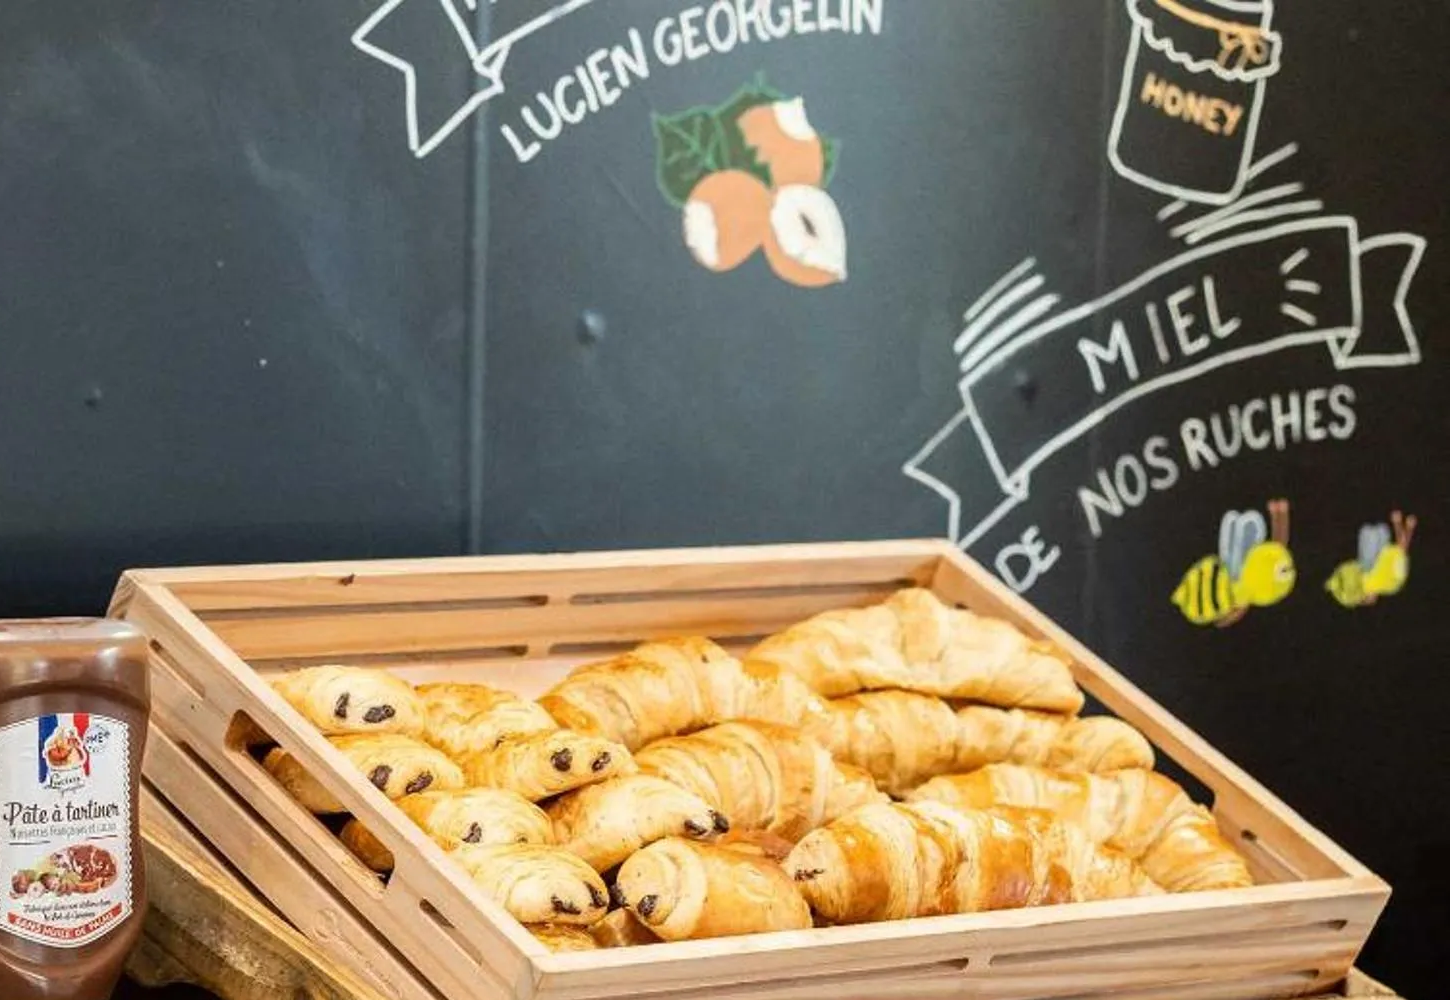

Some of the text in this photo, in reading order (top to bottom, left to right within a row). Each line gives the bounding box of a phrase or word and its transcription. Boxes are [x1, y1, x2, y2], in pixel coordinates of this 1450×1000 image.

[501, 0, 883, 163] LUCIEN GEORGELIN
[1140, 71, 1245, 137] HONEY
[1076, 273, 1242, 393] MIEL
[994, 384, 1358, 594] DE NOS RUCHES
[3, 800, 120, 827] Pâte à tartiner
